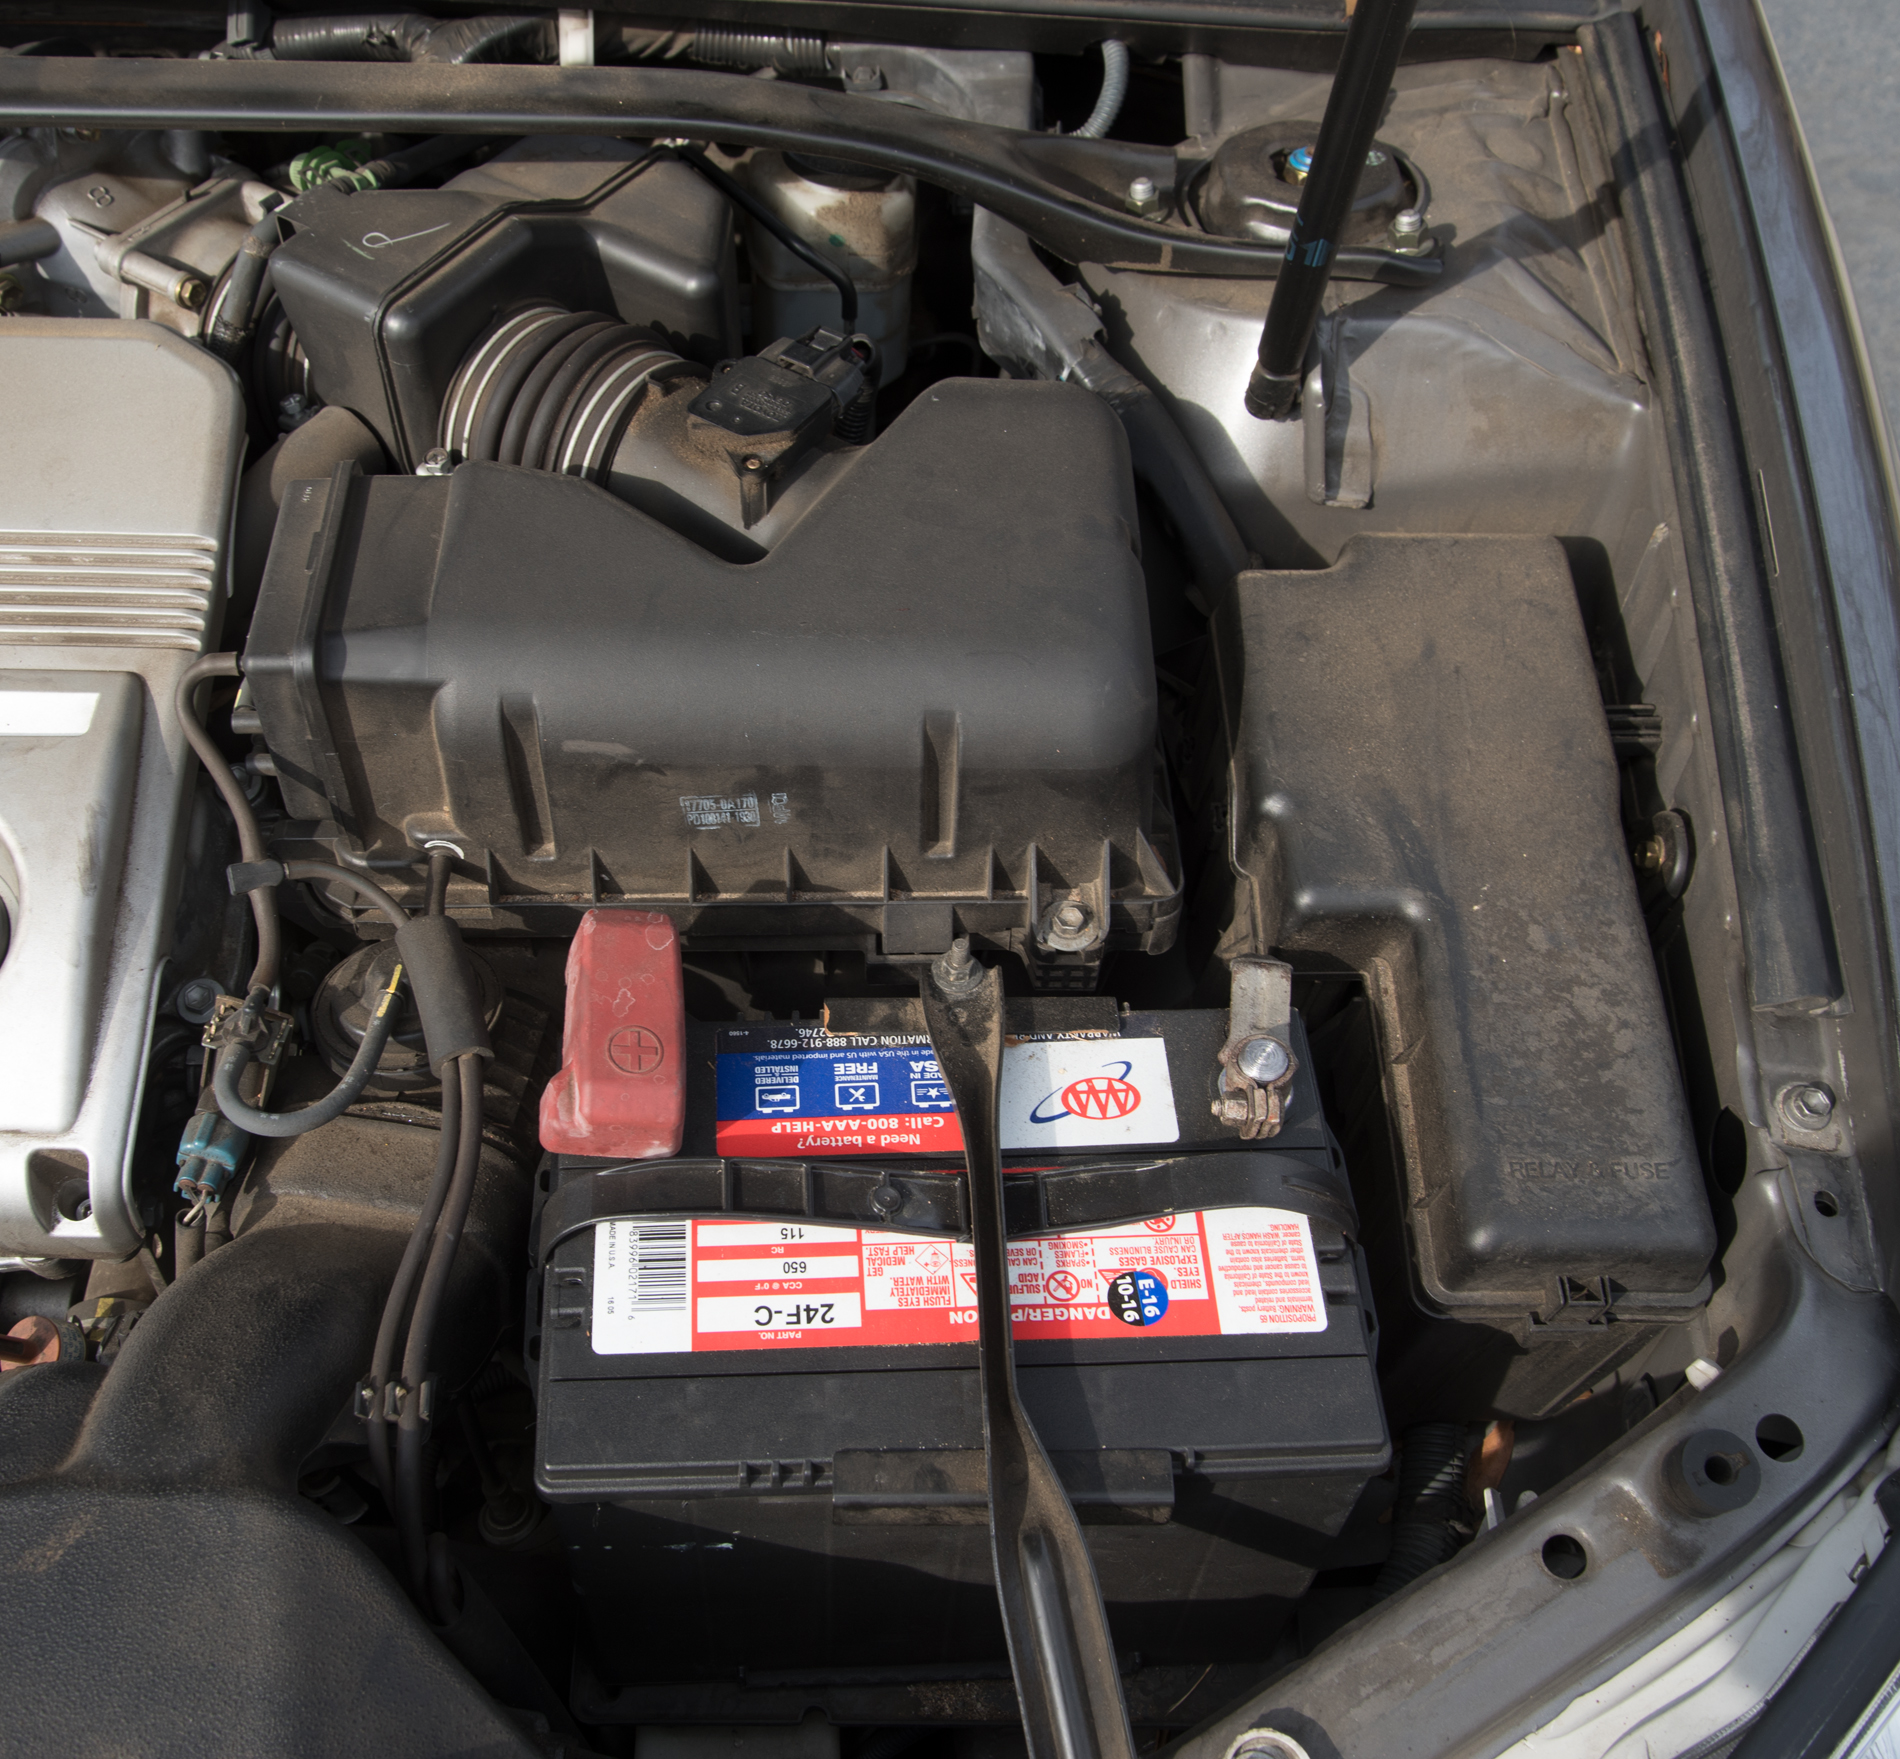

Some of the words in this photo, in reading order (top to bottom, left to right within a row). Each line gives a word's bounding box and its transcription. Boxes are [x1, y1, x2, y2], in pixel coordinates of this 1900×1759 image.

[767, 1037, 847, 1048] 888-912-6678.
[850, 1036, 877, 1046] CALL
[880, 1034, 931, 1045] RMATION
[792, 1052, 828, 1061] imported
[921, 1049, 933, 1057] ade
[754, 1065, 798, 1073] INSTALLED
[833, 1062, 877, 1074] FREE
[909, 1060, 937, 1072] SA
[755, 1076, 799, 1084] DELIVERED
[1064, 1078, 1136, 1119] AAA
[771, 1118, 899, 1133] 800-AAA-HELP
[905, 1116, 944, 1129] Call:
[797, 1133, 862, 1148] battery?
[867, 1135, 875, 1144] a
[881, 1133, 920, 1145] Need
[1509, 1161, 1579, 1178] RELAY
[1611, 1160, 1670, 1180] FUSE
[780, 1228, 804, 1239] 115
[1152, 1237, 1182, 1245] INJURY.
[629, 1231, 638, 1263] 83996
[866, 1247, 889, 1257] FAST.
[891, 1246, 915, 1255] HELP
[1024, 1248, 1036, 1256] OR
[1109, 1247, 1151, 1255] BLINDNESS
[1154, 1246, 1178, 1254] CAUSE
[1181, 1245, 1196, 1253] CAN
[866, 1256, 906, 1266] MEDICAL
[1023, 1257, 1037, 1266] CAN
[1119, 1256, 1147, 1266] GASES
[1150, 1255, 1198, 1265] EXPLOSIVE
[783, 1261, 806, 1273] 650
[867, 1266, 883, 1276] GET
[1174, 1267, 1199, 1276] EYES.
[890, 1276, 924, 1286] WATER.
[926, 1276, 949, 1286] WITH
[1018, 1273, 1039, 1283] ACID
[628, 1268, 637, 1300] 02171
[783, 1281, 802, 1289] CCA
[1081, 1279, 1092, 1288] NO
[1171, 1279, 1201, 1289] SHIELD
[890, 1286, 950, 1297] IMMEDIATELY
[608, 1297, 614, 1305] 16
[898, 1297, 920, 1307] EYES
[923, 1296, 950, 1306] FLUSH
[1116, 1275, 1140, 1322] 10-16
[1138, 1279, 1160, 1317] E-16
[607, 1306, 614, 1314] 05
[1277, 1304, 1315, 1313] WARNING:
[754, 1303, 835, 1326] 24F-C
[1260, 1315, 1267, 1323] 65
[1268, 1314, 1316, 1323] PROPOSITION
[777, 1331, 802, 1339] PART
